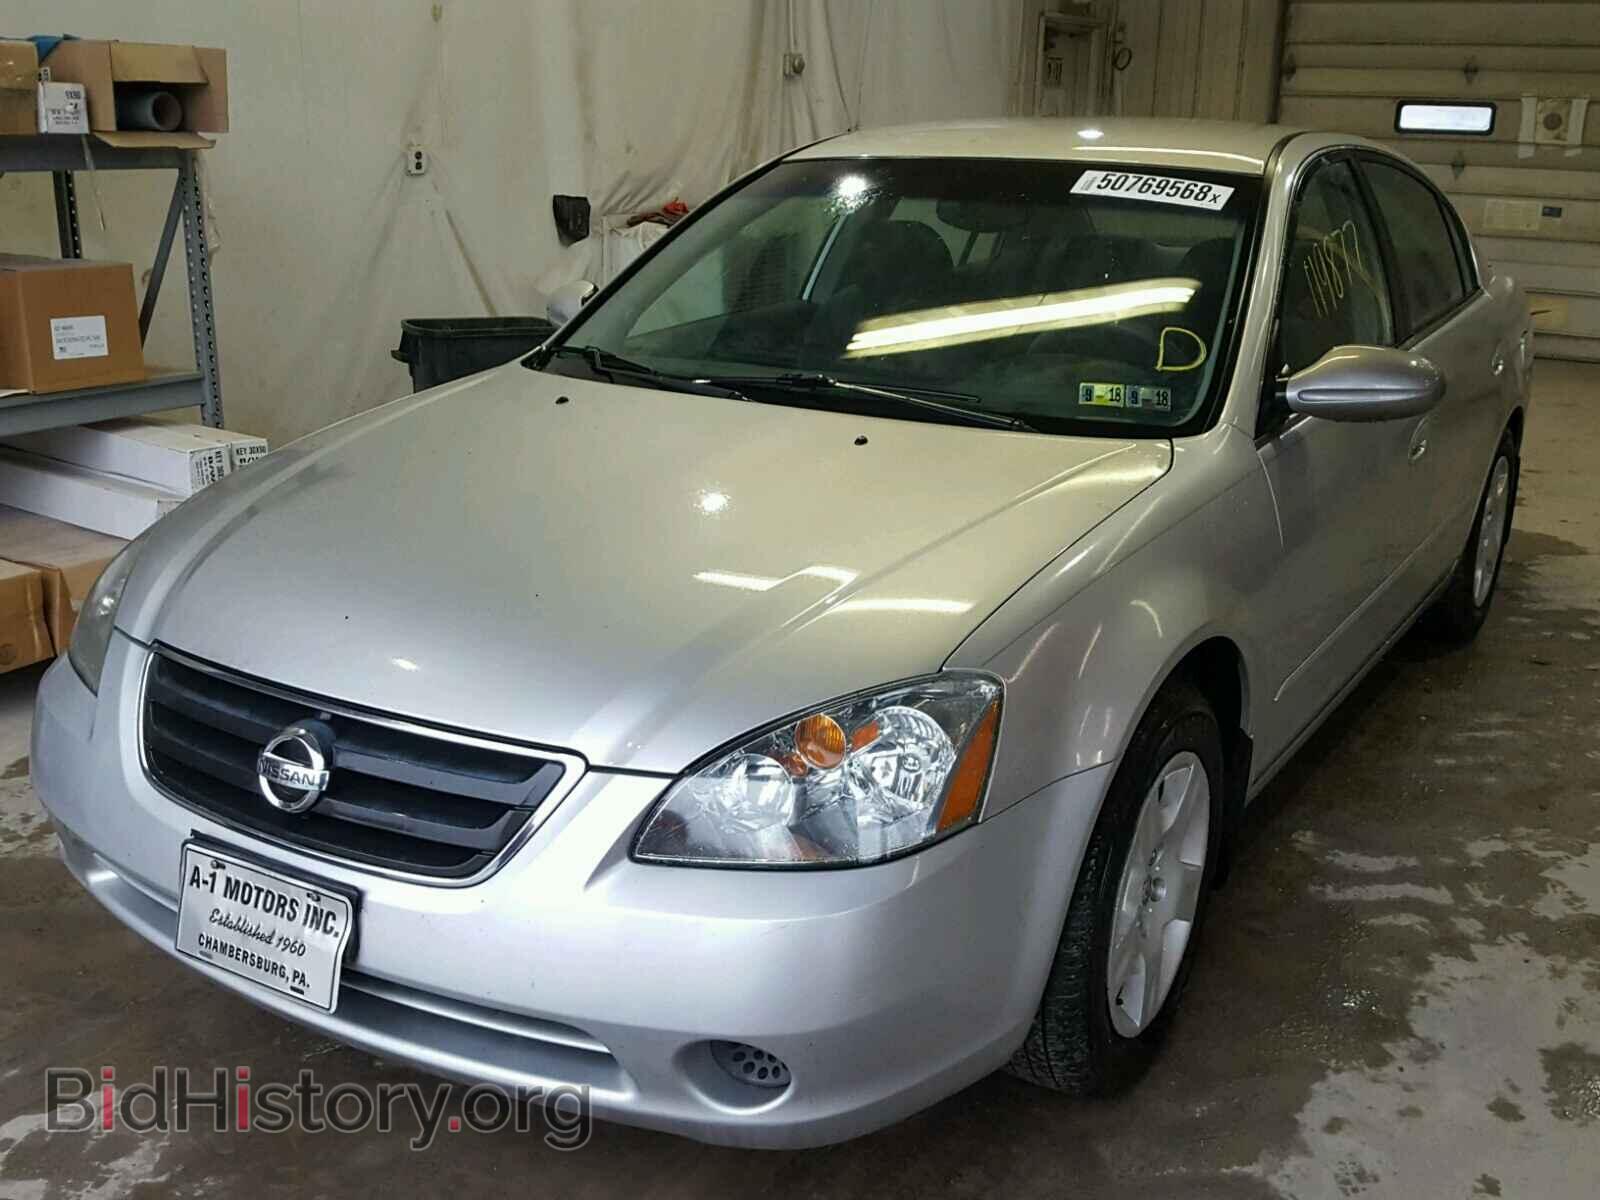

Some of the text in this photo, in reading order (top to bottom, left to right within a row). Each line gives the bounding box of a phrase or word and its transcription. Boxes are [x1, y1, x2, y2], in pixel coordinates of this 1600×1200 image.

[1155, 326, 1207, 372] D
[1109, 387, 1122, 402] 18
[1155, 390, 1169, 407] 18
[260, 759, 316, 786] NISSAN
[189, 864, 340, 938] A-1 MOTORS INC.
[209, 908, 307, 957] Established 1960
[198, 933, 310, 988] CHAMBERSBURG, PA.
